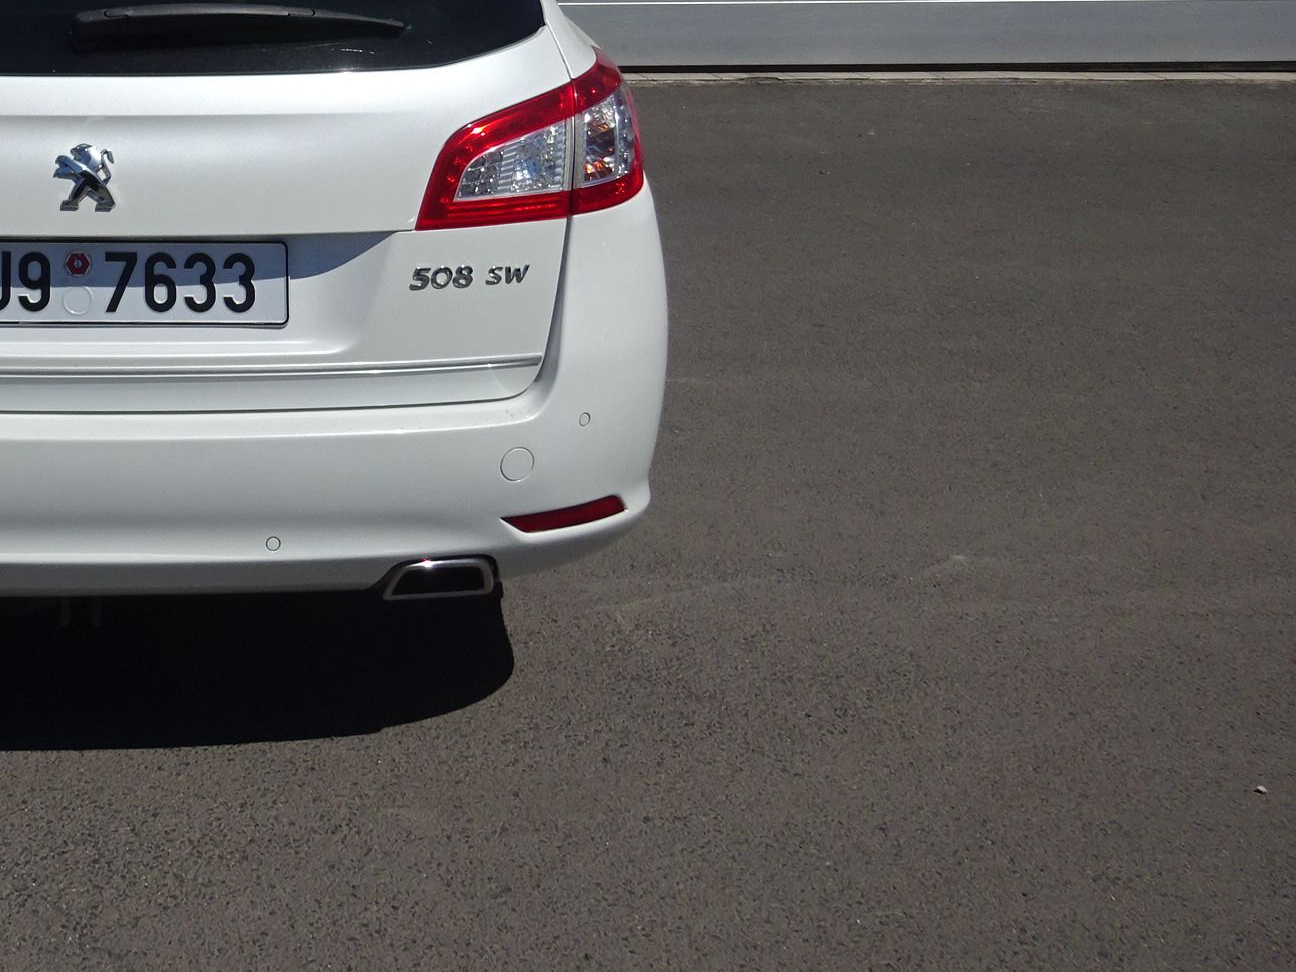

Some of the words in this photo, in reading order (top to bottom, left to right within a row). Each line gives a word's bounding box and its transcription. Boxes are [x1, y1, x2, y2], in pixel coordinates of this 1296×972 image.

[105, 252, 256, 313] 7633
[409, 265, 474, 291] 508
[485, 264, 530, 286] SW
